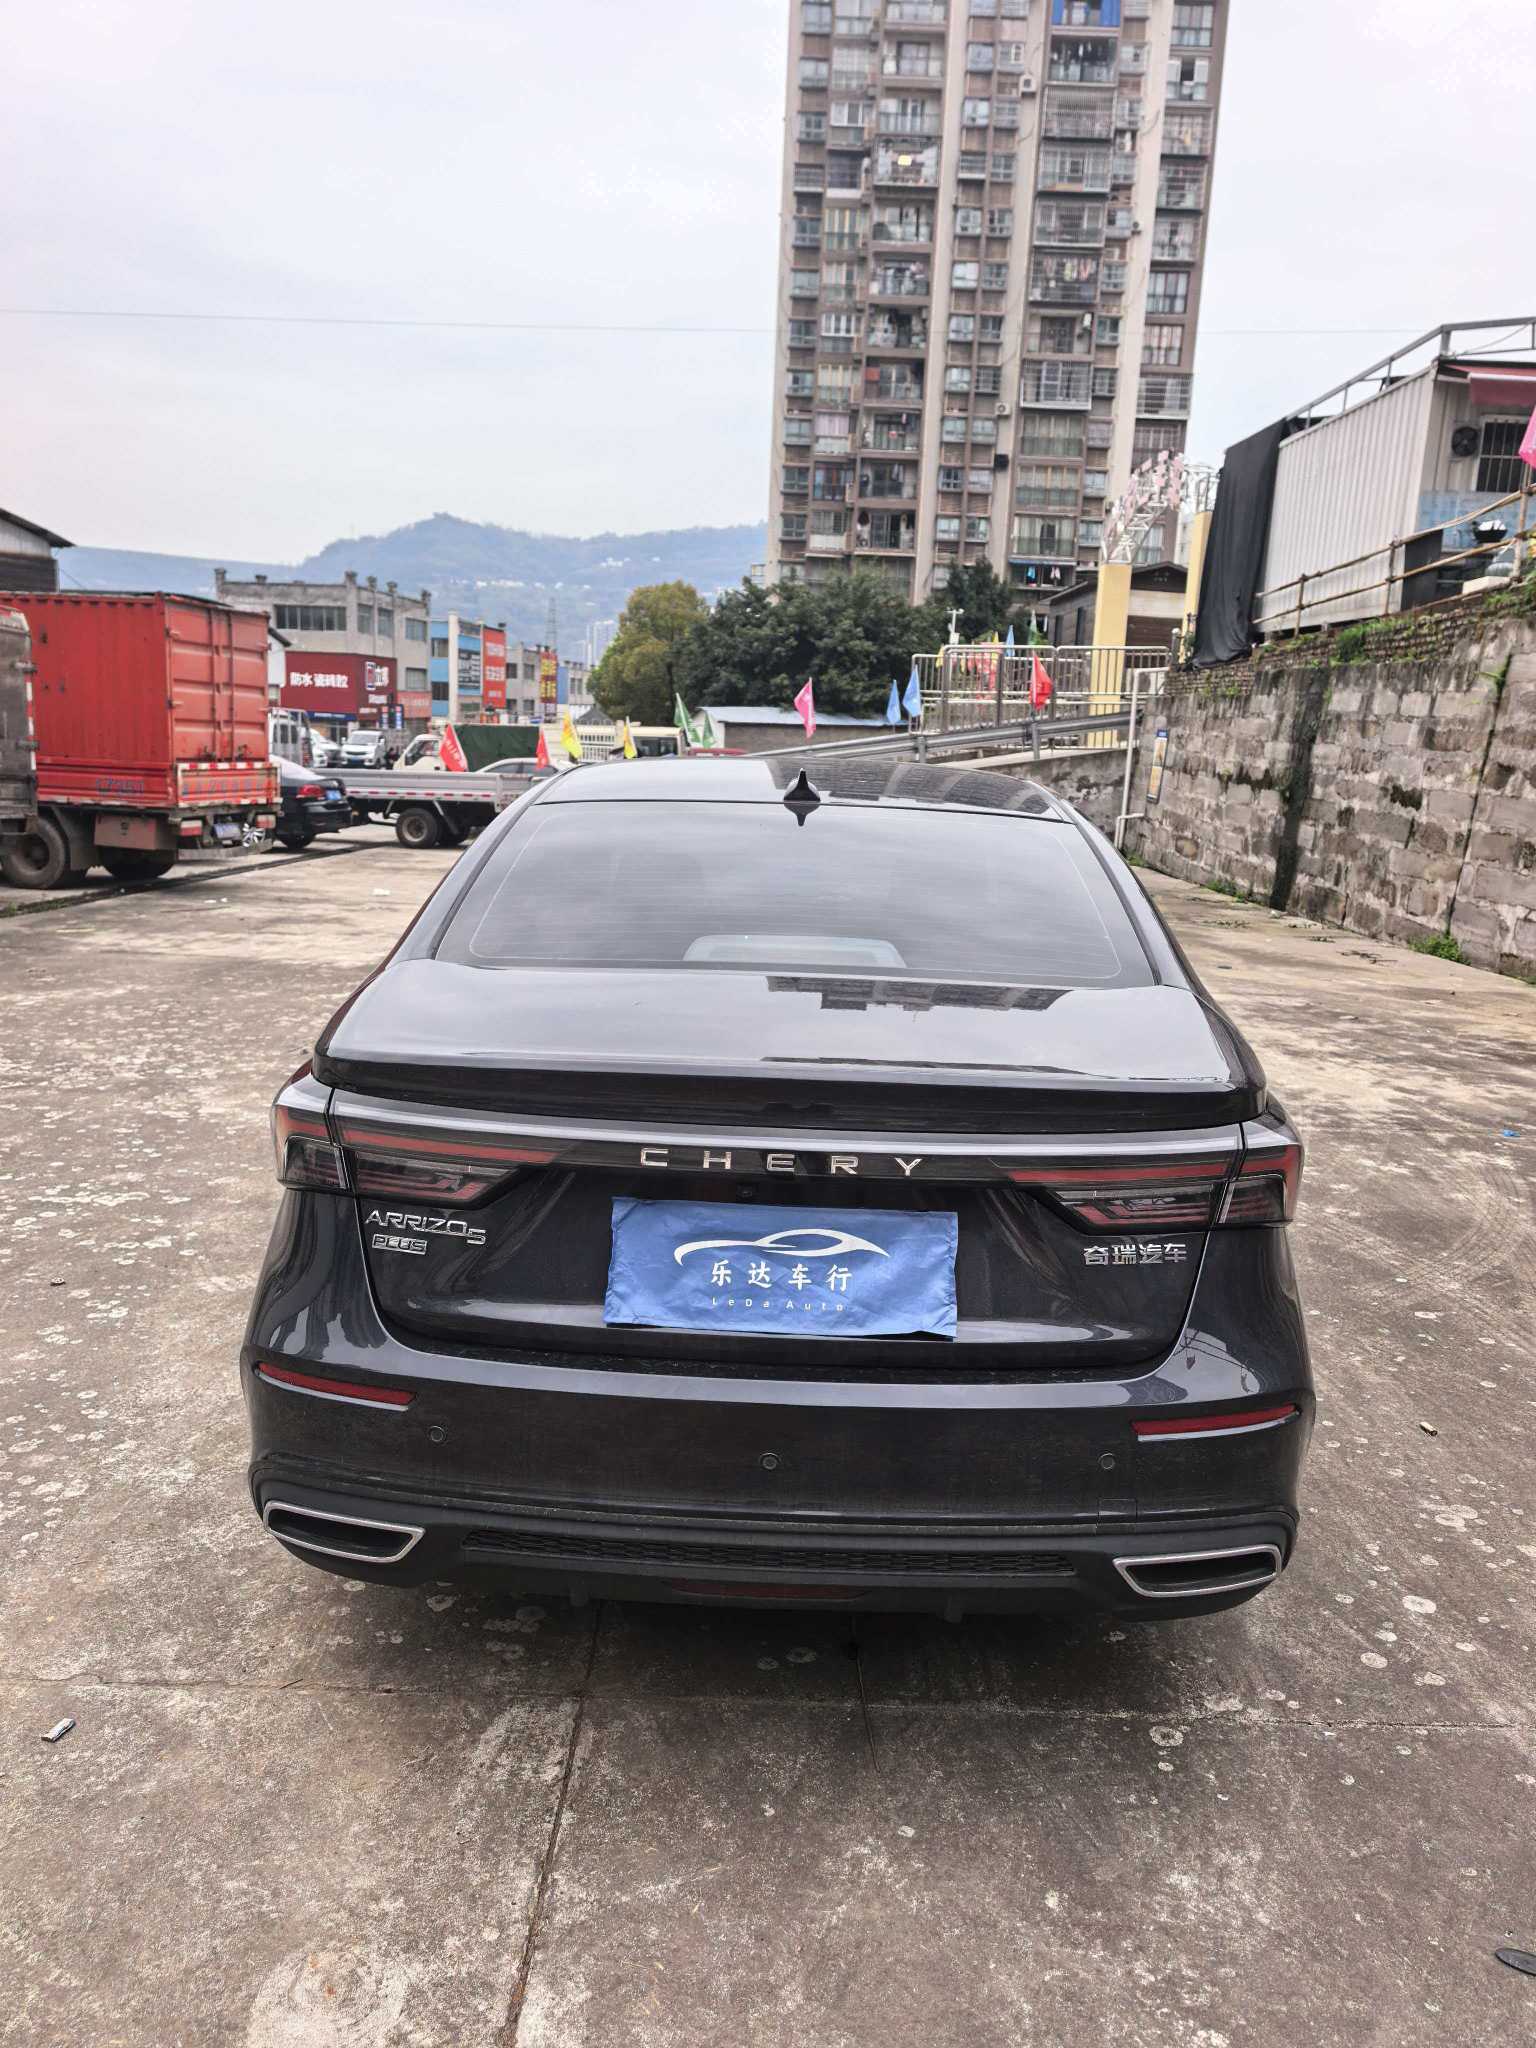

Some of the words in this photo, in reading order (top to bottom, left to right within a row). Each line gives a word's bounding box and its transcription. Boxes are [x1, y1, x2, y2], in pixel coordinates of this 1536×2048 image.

[640, 1147, 923, 1177] CHERY
[1083, 1243, 1188, 1266] 奇瑞汽车
[710, 1259, 853, 1292] 乐达车行
[712, 1297, 770, 1308] LeDa
[785, 1299, 846, 1312] Auto
